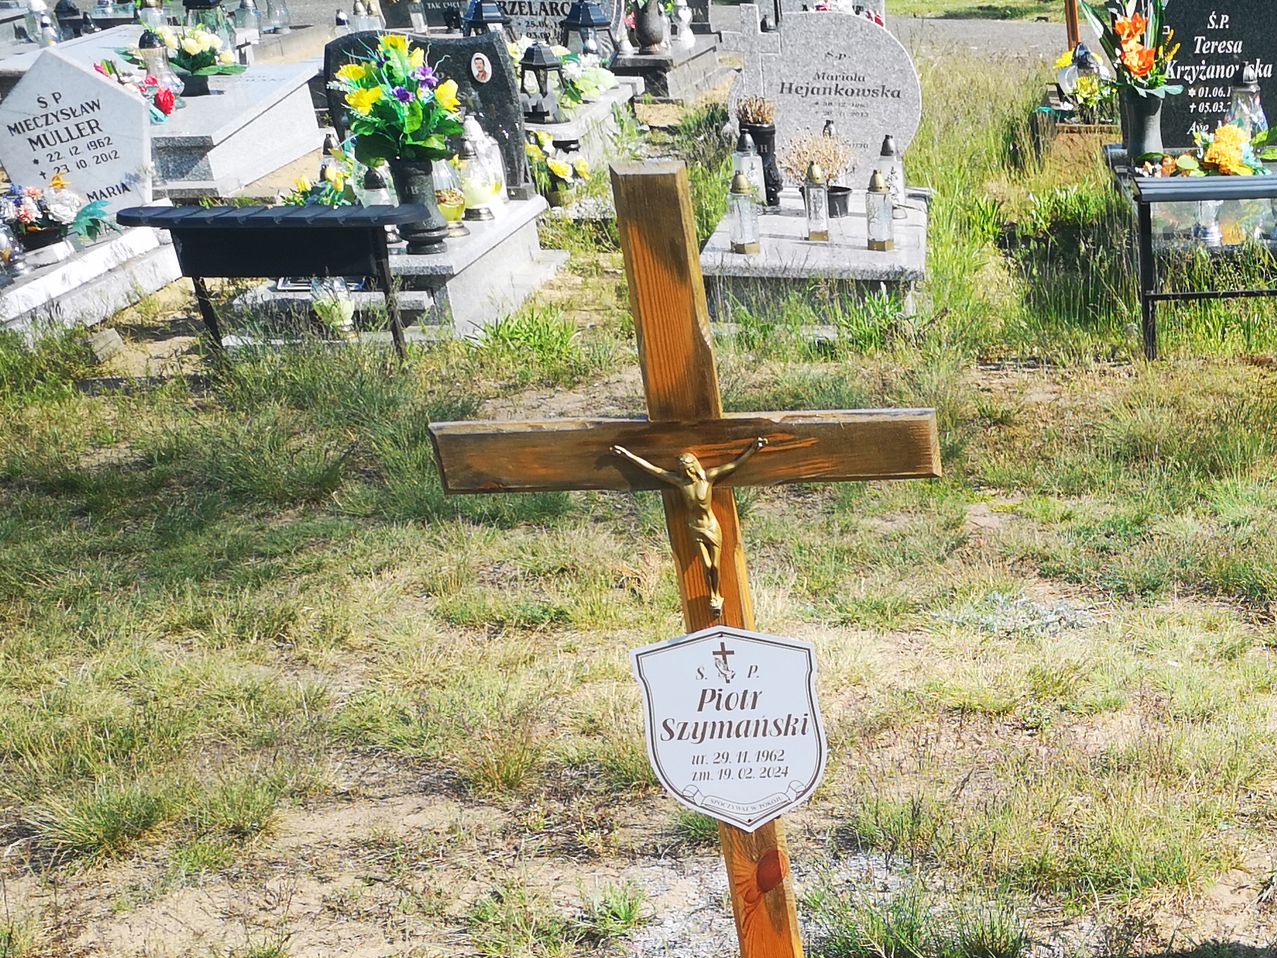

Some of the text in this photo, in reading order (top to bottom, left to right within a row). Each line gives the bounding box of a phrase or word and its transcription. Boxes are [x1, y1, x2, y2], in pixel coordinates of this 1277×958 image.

[1193, 36, 1243, 54] Teresa
[812, 71, 866, 83] Mariola
[779, 82, 902, 99] Hejankowska
[1197, 87, 1231, 98] 01.06.1
[7, 99, 101, 136] MIECZYSŁAW
[86, 136, 113, 151] 1962
[92, 149, 120, 165] 2012
[86, 182, 131, 203] MARIA
[747, 664, 760, 679] P.
[697, 688, 763, 712] Piotr
[660, 713, 809, 745] Szymański
[691, 749, 785, 765] ur. 29. 11. 1962
[691, 766, 789, 781] zm. 19. 02. 2024
